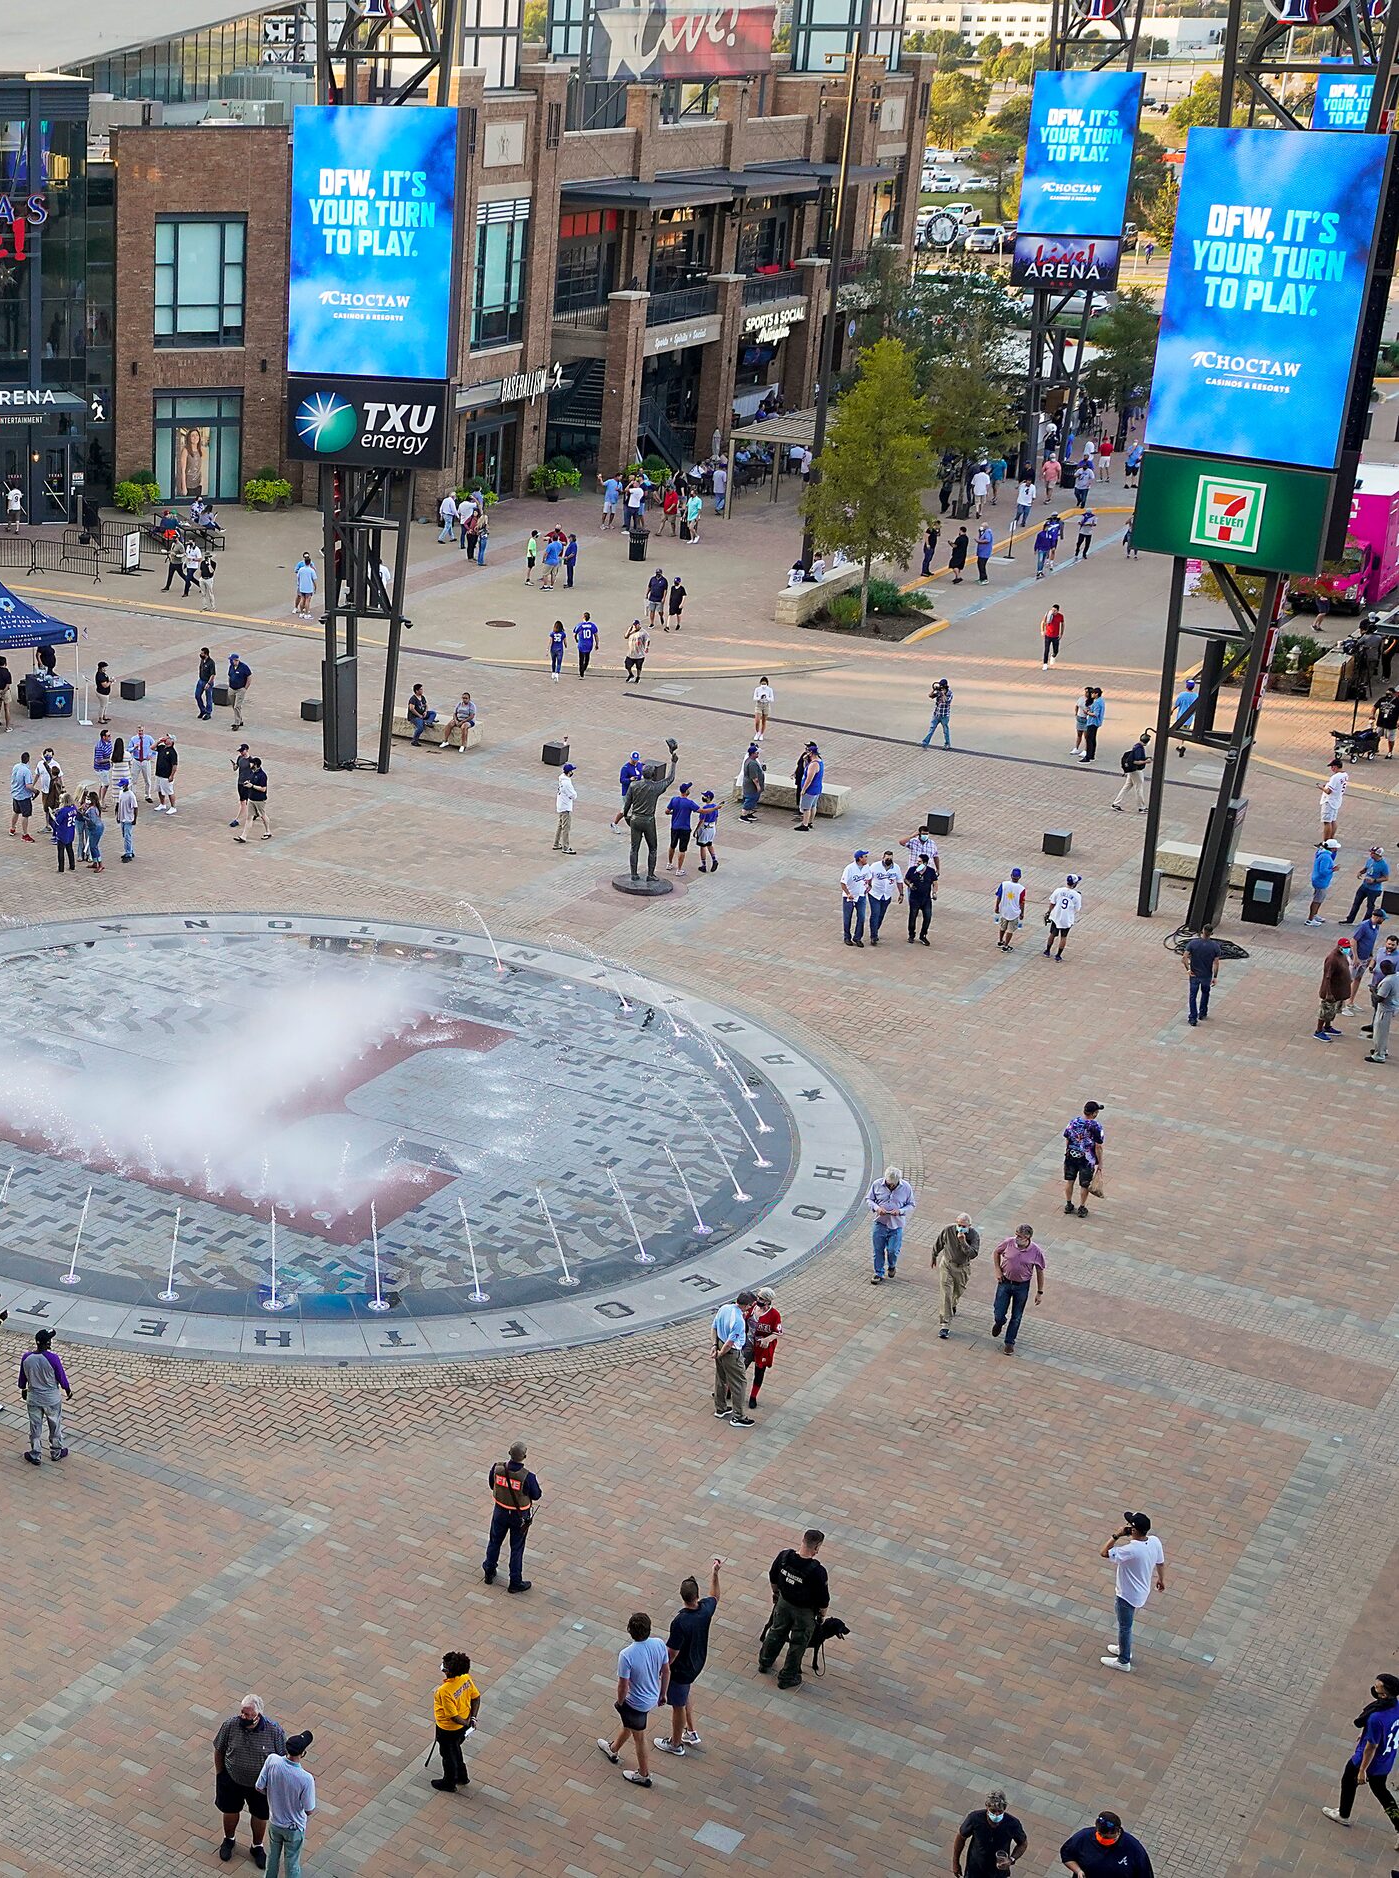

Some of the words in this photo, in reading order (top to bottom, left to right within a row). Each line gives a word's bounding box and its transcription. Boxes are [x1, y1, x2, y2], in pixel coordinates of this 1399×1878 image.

[1329, 84, 1359, 99] DFW,
[1323, 98, 1355, 111] YOUR
[1047, 108, 1085, 129] DFW,
[1089, 109, 1119, 126] IT'S
[1328, 111, 1344, 124] TO
[1040, 125, 1078, 144] YOUR
[1083, 126, 1123, 145] TURN
[1047, 144, 1067, 162] TO
[1069, 145, 1110, 163] PLAY.
[319, 168, 376, 200] DFW,
[383, 170, 427, 198] IT'S
[1049, 182, 1102, 193] CHOCTAW
[308, 199, 368, 226] YOUR
[375, 201, 435, 228] TURN
[1207, 205, 1276, 247] DFW,
[1281, 211, 1340, 244] IT'S
[323, 228, 351, 255] TO
[358, 229, 419, 257] PLAY.
[1036, 243, 1096, 267] Live!
[1192, 239, 1265, 275] YOUR
[1271, 244, 1345, 282] TURN
[1024, 263, 1101, 280] ARENA
[328, 290, 411, 308] CHOCTAW
[1203, 275, 1241, 310] TO
[1244, 279, 1319, 317] PLAY.
[333, 312, 364, 320] CASINOS
[745, 313, 773, 332] SPORTS
[779, 307, 806, 325] SOCIAL
[1202, 351, 1302, 378] CHOCTAW
[501, 369, 547, 406] BASEBALLISM
[1205, 377, 1242, 389] CASINOS
[1251, 382, 1290, 394] RESORTS
[362, 402, 436, 434] TXU
[361, 432, 429, 456] energy
[583, 629, 592, 639] 10
[1061, 898, 1069, 910] 9
